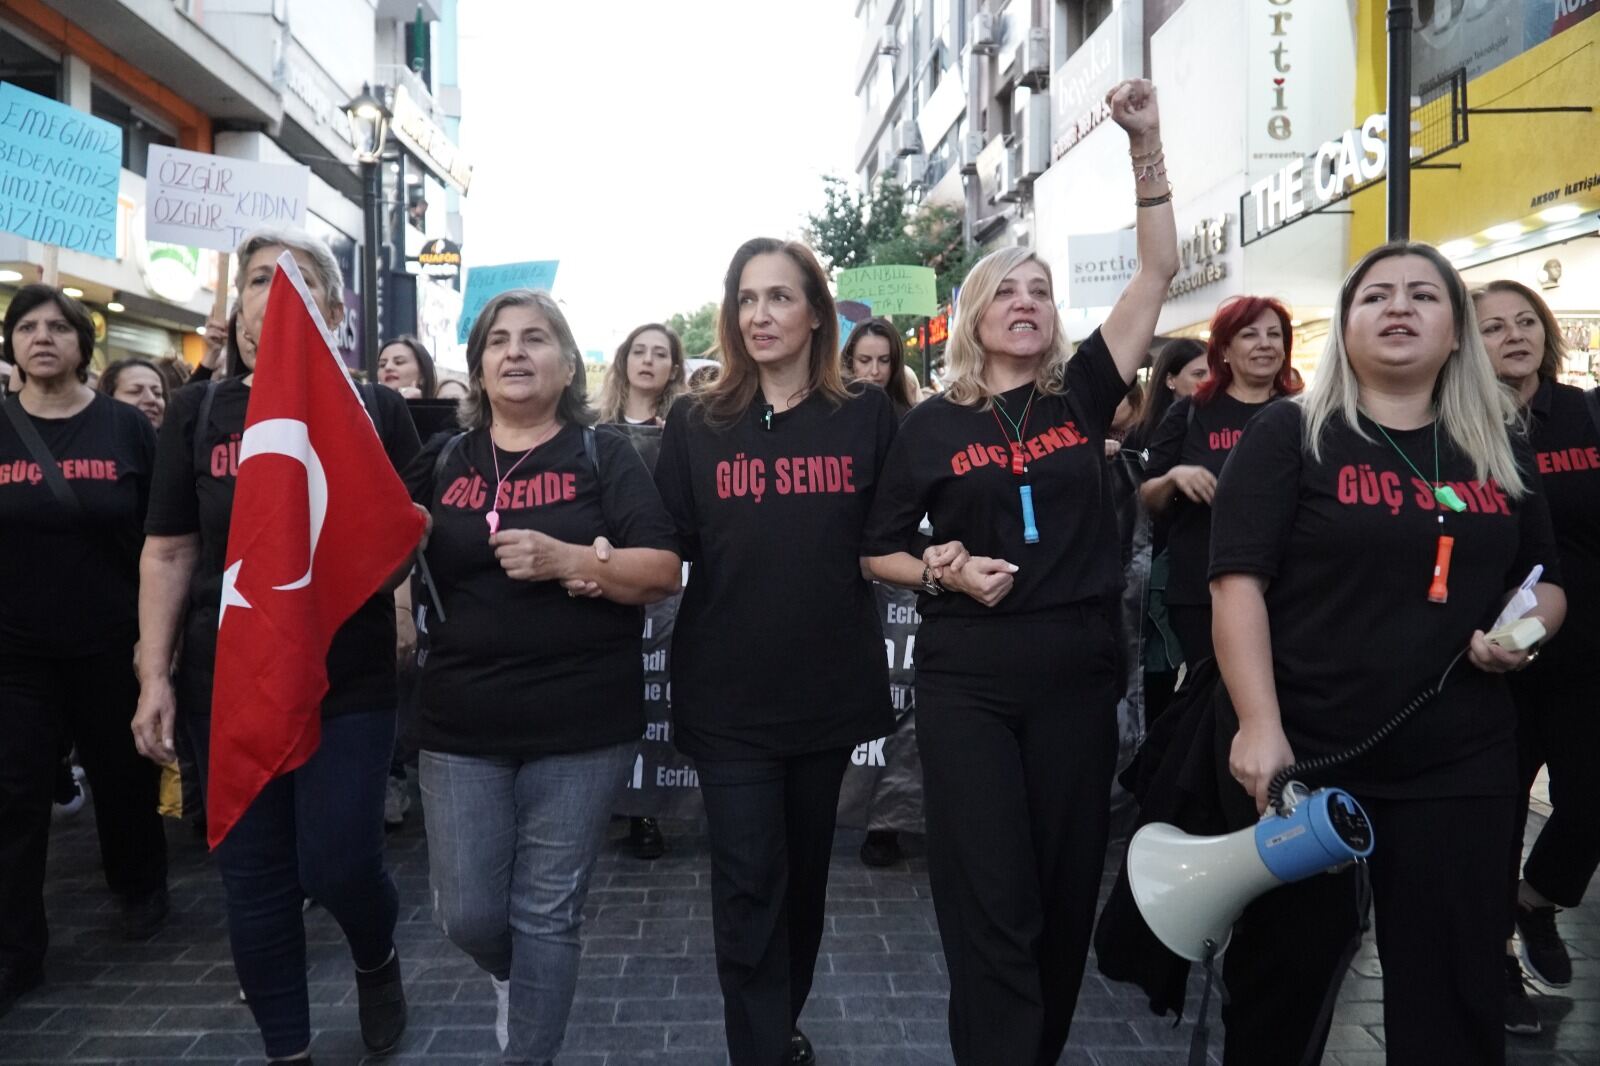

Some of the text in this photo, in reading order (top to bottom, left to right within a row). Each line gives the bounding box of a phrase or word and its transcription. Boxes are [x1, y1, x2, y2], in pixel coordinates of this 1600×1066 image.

[1251, 114, 1422, 232] THE CAS
[235, 191, 298, 221] KADIN
[1531, 188, 1561, 207] AKSOY
[1075, 256, 1137, 274] sortie
[0, 459, 118, 485] GÜÇ ENDE
[951, 442, 1009, 476] GÜÇ
[1536, 448, 1600, 474] ENDE
[495, 472, 577, 509] SENDE
[716, 452, 856, 503] GÜÇ SENDE
[1338, 464, 1403, 515] GÜÇ
[656, 765, 699, 788] Ecrin
